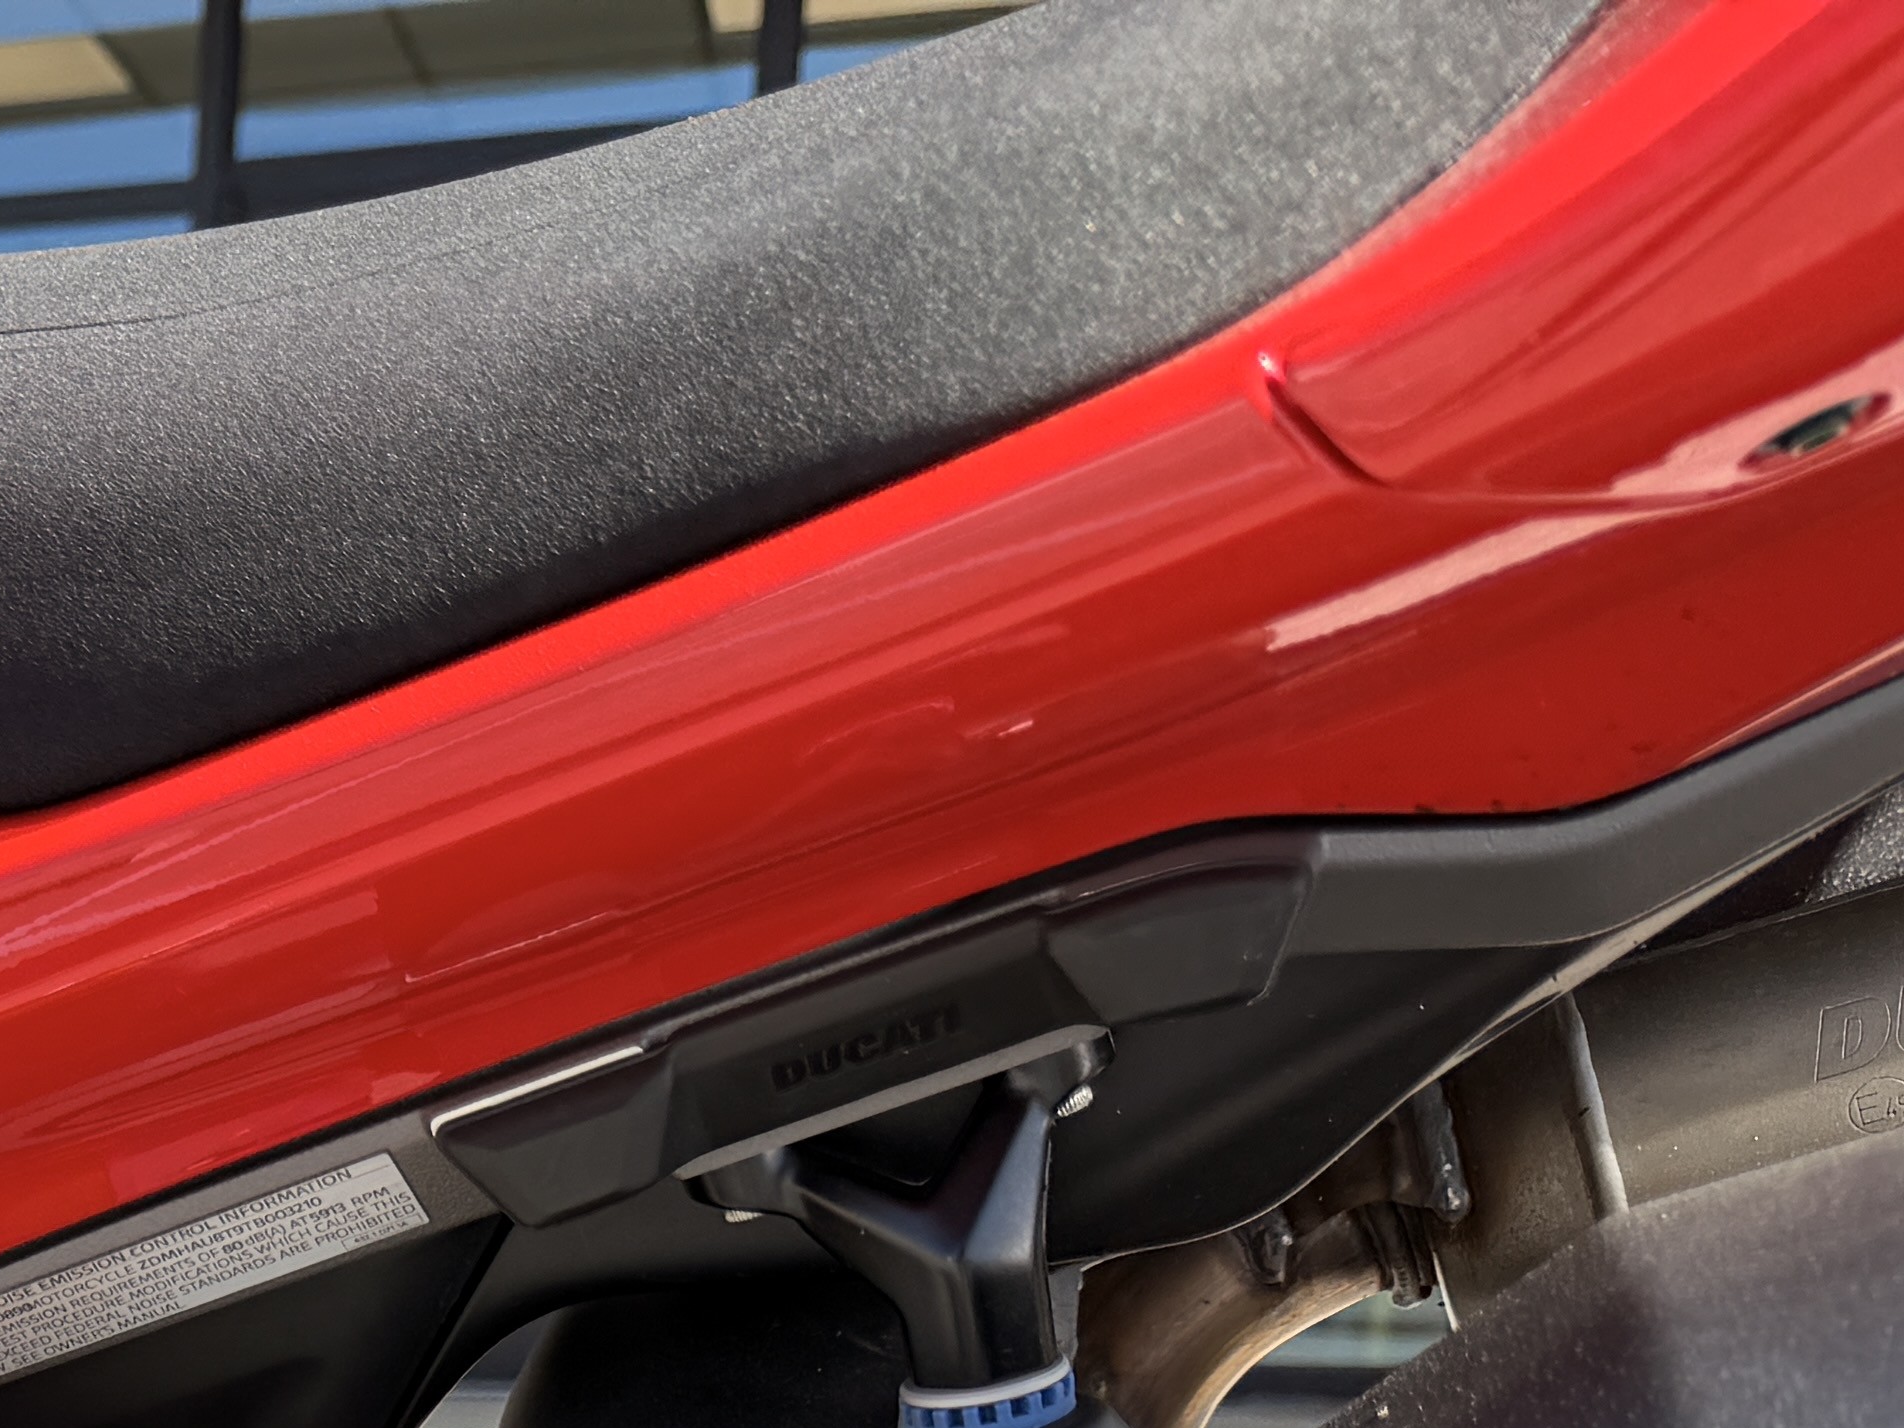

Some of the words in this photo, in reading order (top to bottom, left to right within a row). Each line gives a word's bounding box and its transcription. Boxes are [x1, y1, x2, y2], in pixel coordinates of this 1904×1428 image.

[771, 1004, 960, 1093] DUCATI
[38, 1254, 124, 1291] EMISSION
[128, 1220, 215, 1258] CONTROL
[218, 1169, 351, 1225] INFORMATION
[54, 1309, 124, 1339] FEDERAL
[127, 1290, 176, 1313] NOISE
[178, 1255, 275, 1295] STANDARDS
[277, 1241, 311, 1259] ARE
[314, 1204, 415, 1246] PROHIBITED
[69, 1258, 194, 1309] REQUIREMENTS
[197, 1248, 219, 1262] OF
[220, 1240, 242, 1254] 80
[243, 1225, 284, 1245] dB(A)
[288, 1216, 308, 1229] AT
[350, 1187, 388, 1206] RPM
[128, 1250, 251, 1300] MODIFICATIONS
[254, 1229, 310, 1254] WHICH
[314, 1208, 368, 1233] CAUSE
[370, 1192, 409, 1212] THIS
[11, 1351, 42, 1366] SEE
